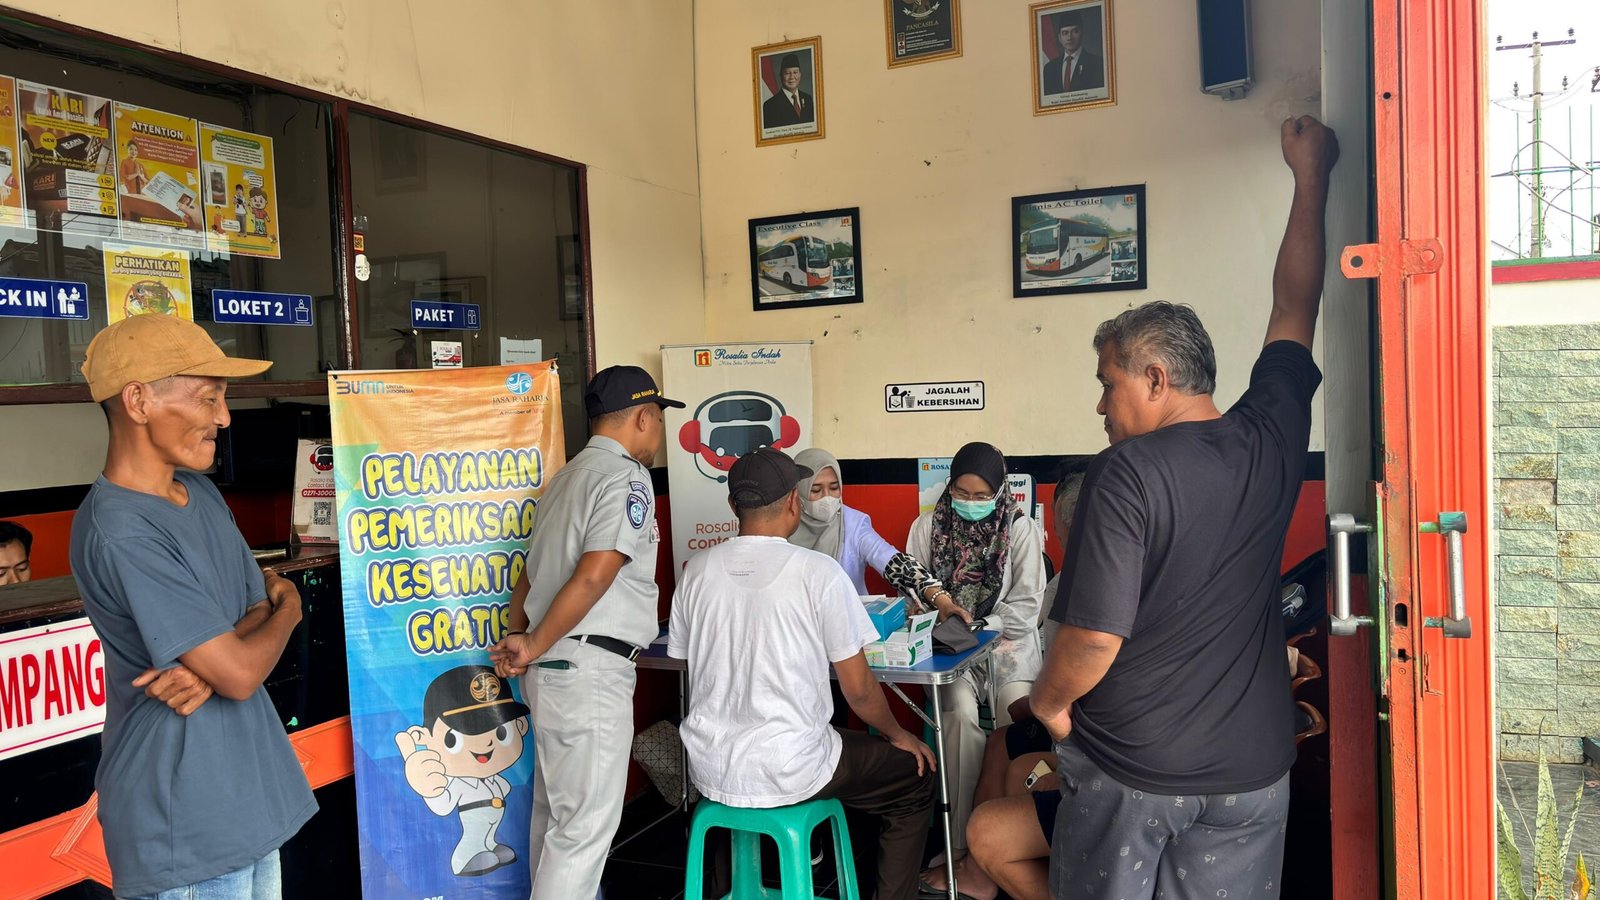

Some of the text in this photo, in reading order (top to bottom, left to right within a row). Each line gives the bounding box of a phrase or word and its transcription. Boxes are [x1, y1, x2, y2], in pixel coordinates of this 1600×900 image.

[906, 20, 939, 31] PANCASILA
[51, 95, 84, 114] KARI
[131, 121, 183, 142] ATTENTION
[33, 174, 56, 186] KARI
[1055, 200, 1071, 208] AC
[1073, 197, 1103, 206] Toilet
[758, 220, 821, 233] Executive Class
[115, 256, 180, 272] PERHATIKAN
[26, 290, 47, 307] IN
[218, 299, 284, 316] LOKET 2
[415, 308, 454, 322] PAKET
[714, 348, 781, 361] Rosalia Indah
[926, 387, 970, 395] JAGALAH
[917, 398, 979, 406] KEBERSIHAN
[363, 449, 542, 499] PELAYANAN
[696, 520, 740, 534] Rosali
